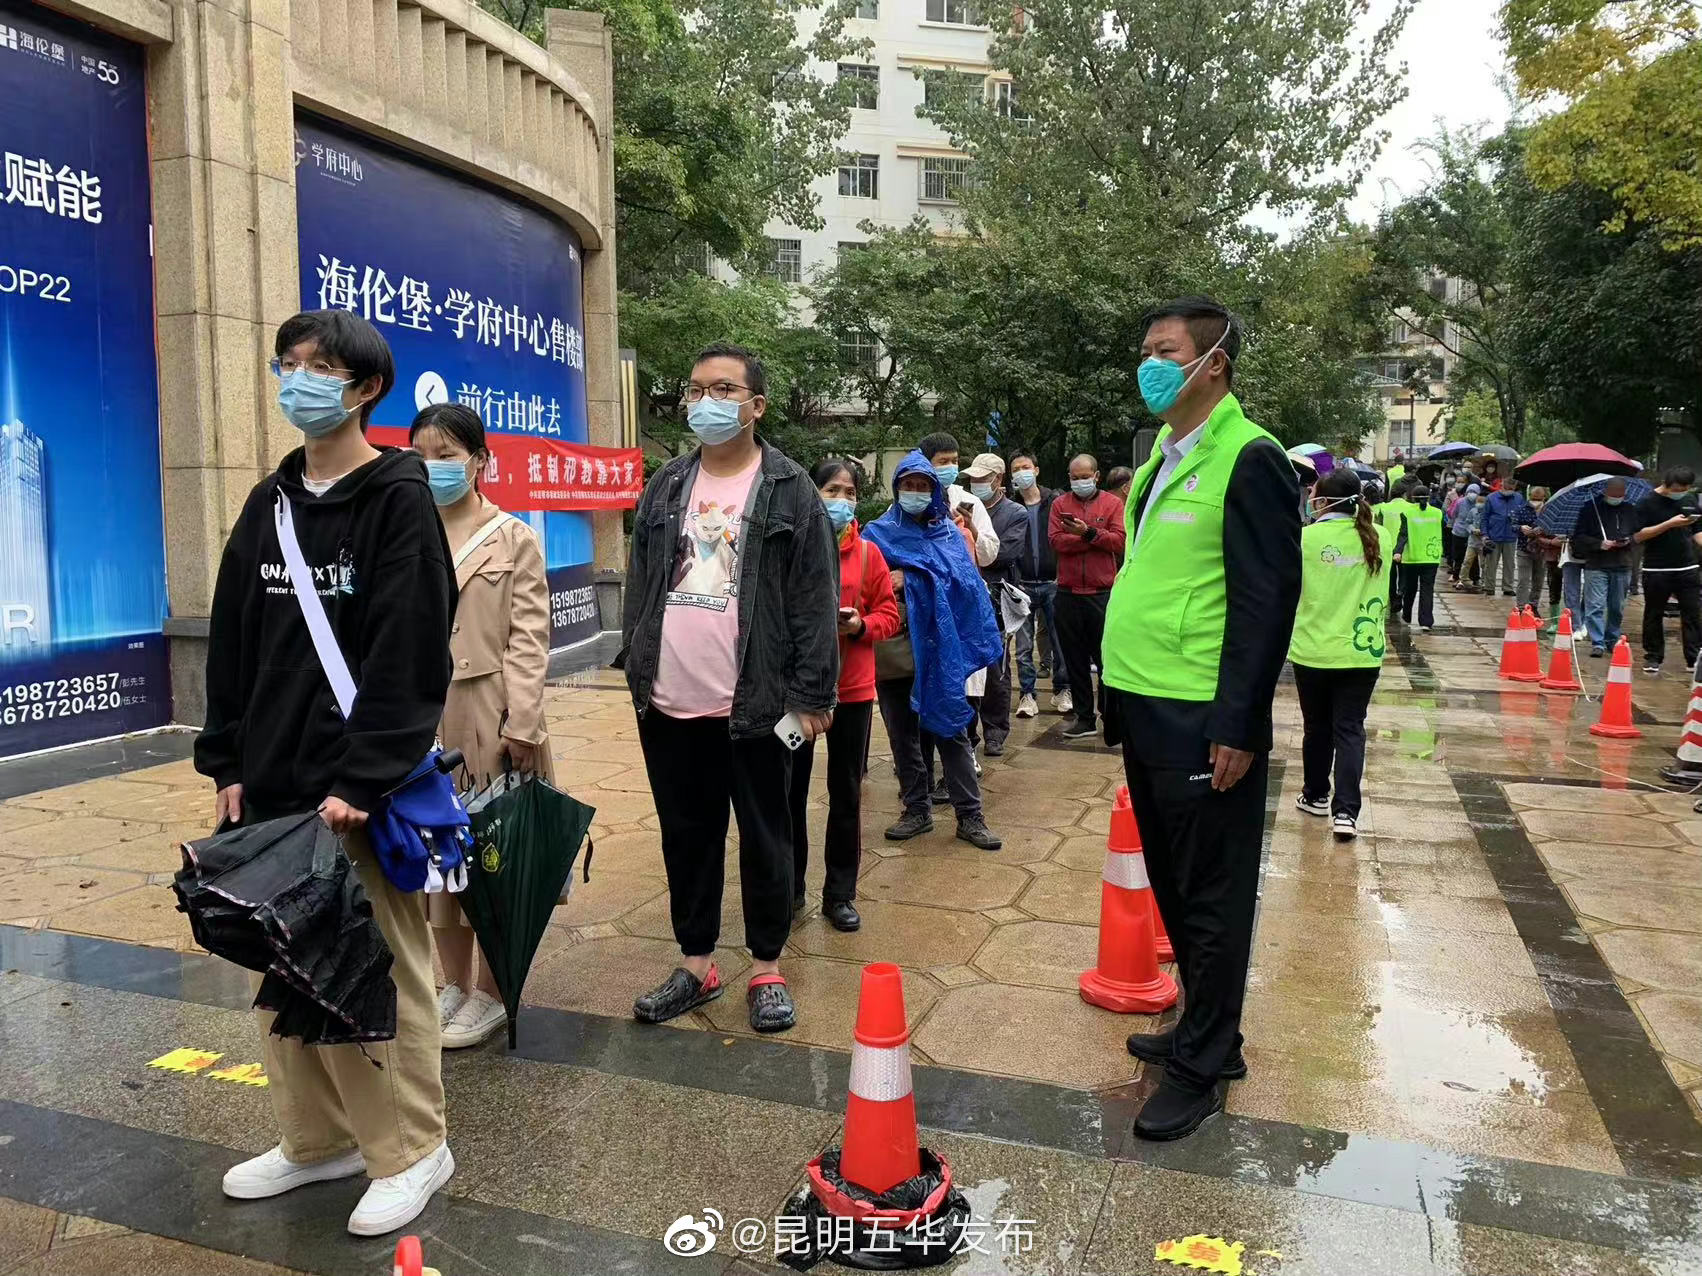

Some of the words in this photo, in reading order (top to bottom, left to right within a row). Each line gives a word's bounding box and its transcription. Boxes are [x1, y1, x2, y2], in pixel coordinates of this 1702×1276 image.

[20, 31, 65, 61] 海伦堡
[312, 142, 363, 182] 学府中心
[0, 151, 103, 225] 赋能
[456, 382, 561, 436] 前行由此去
[0, 672, 119, 704] 198723657
[0, 691, 121, 726] 678720420
